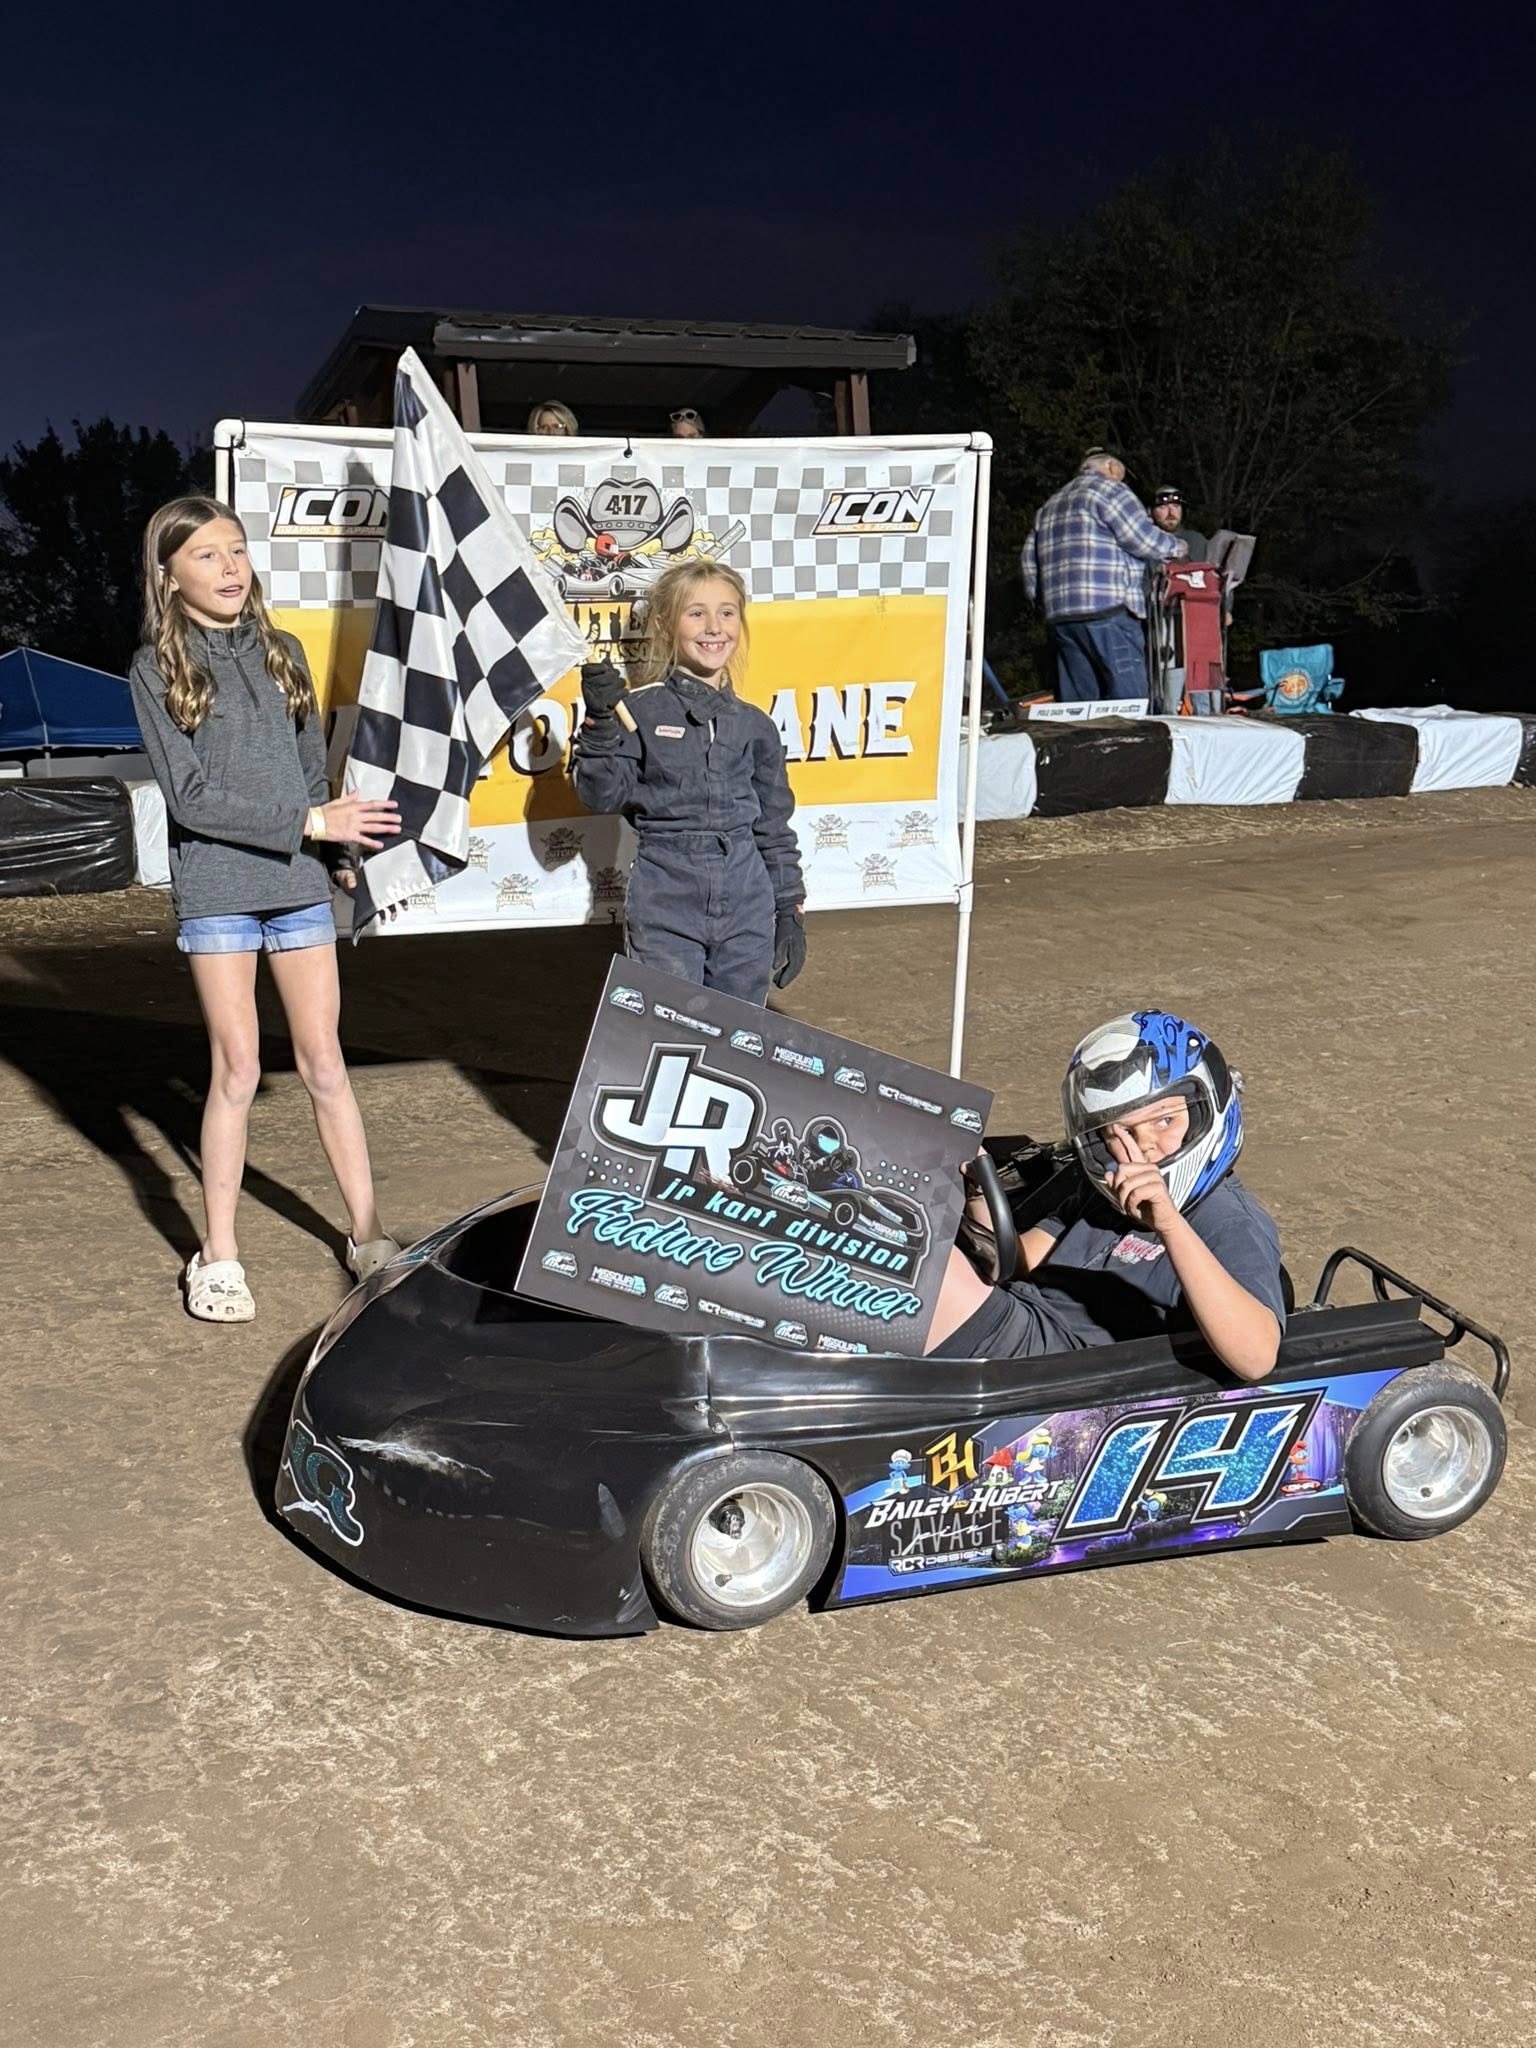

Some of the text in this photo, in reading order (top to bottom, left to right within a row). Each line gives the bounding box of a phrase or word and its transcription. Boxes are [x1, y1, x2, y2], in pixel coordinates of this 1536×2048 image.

[605, 494, 648, 515] 417
[819, 488, 935, 525] ICON
[769, 680, 917, 763] ANE
[775, 1046, 814, 1067] MISSOURI
[602, 1055, 755, 1187] JR
[656, 1178, 909, 1271] jr kart division
[566, 1188, 923, 1321] Feature Winner
[591, 1266, 634, 1284] MISSOURI
[1060, 1398, 1312, 1534] 14
[864, 1496, 957, 1528] BAILEY
[965, 1479, 1063, 1515] HUBERT
[891, 1507, 1004, 1557] SAVAGE
